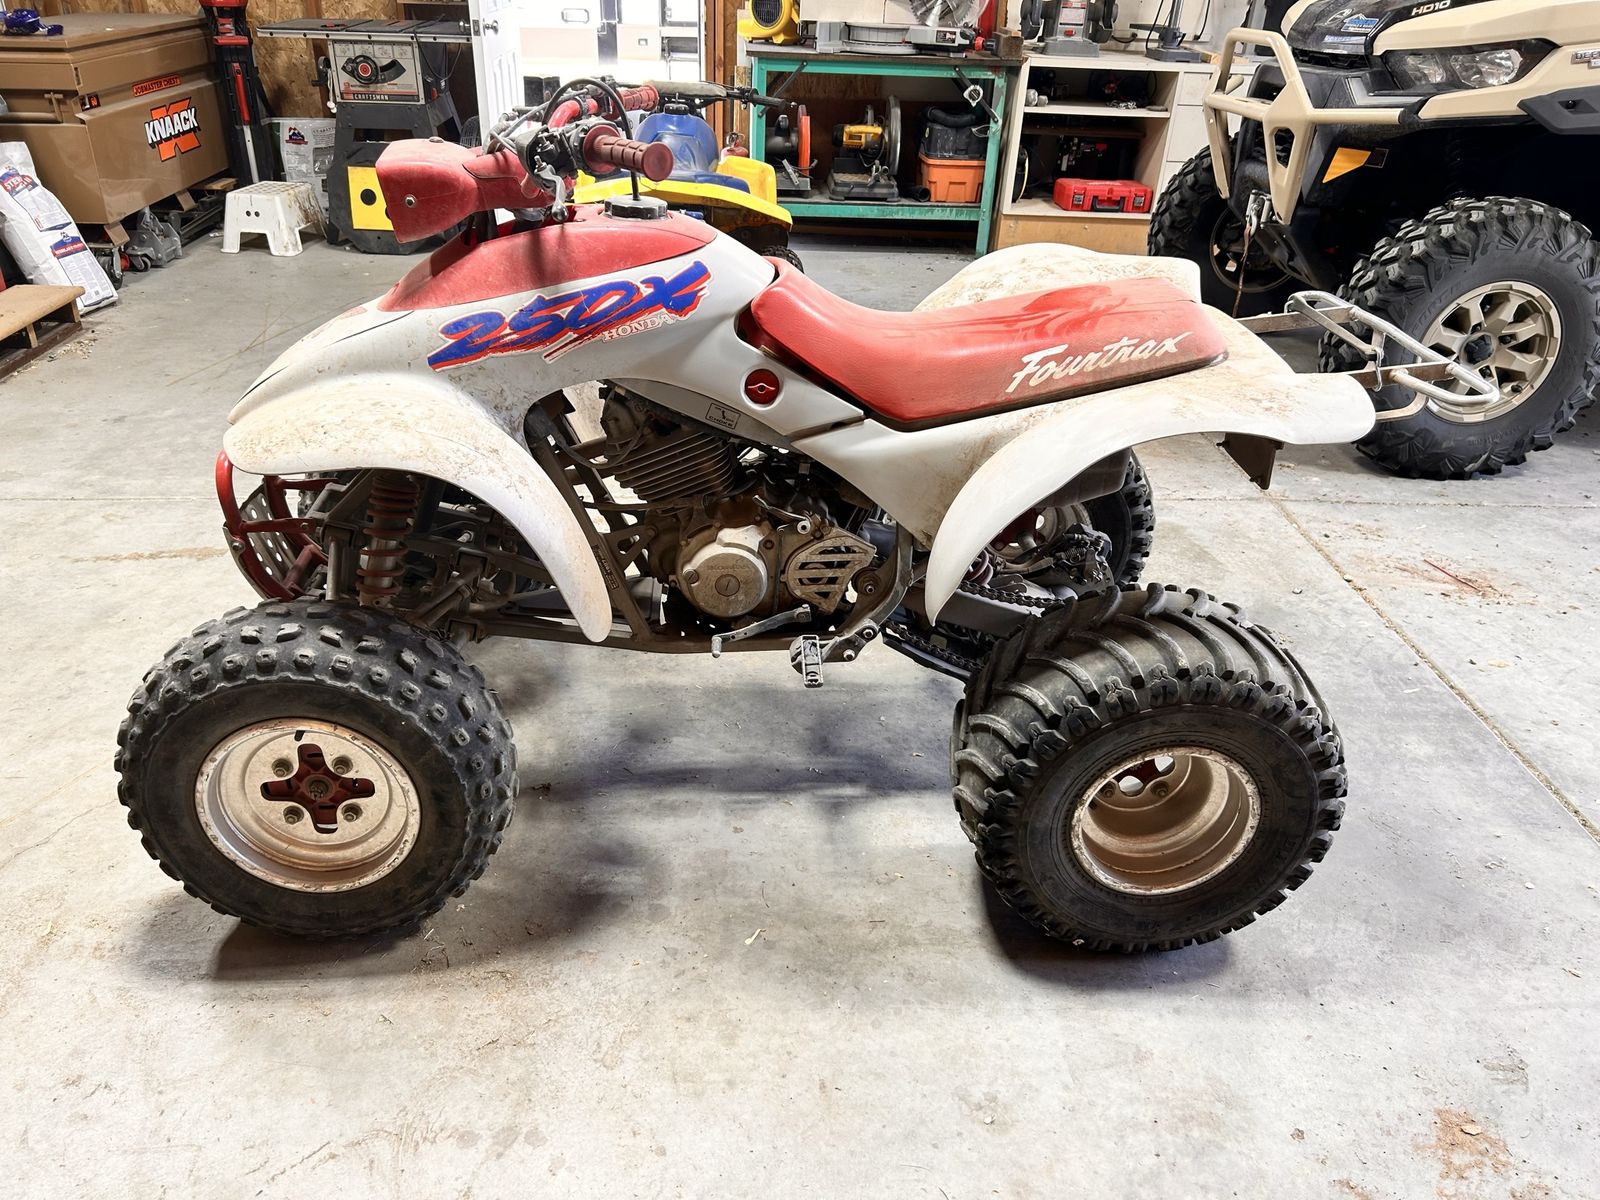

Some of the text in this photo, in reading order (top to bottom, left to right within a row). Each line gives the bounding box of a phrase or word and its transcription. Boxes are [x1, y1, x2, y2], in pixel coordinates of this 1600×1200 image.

[1411, 0, 1450, 15] HD10
[164, 76, 179, 88] CHEST
[354, 93, 389, 101] CRAFTSMAN
[144, 107, 199, 146] KNAACK
[427, 260, 712, 370] 250X
[603, 313, 676, 341] HONDA
[1005, 331, 1193, 393] Fourtrax
